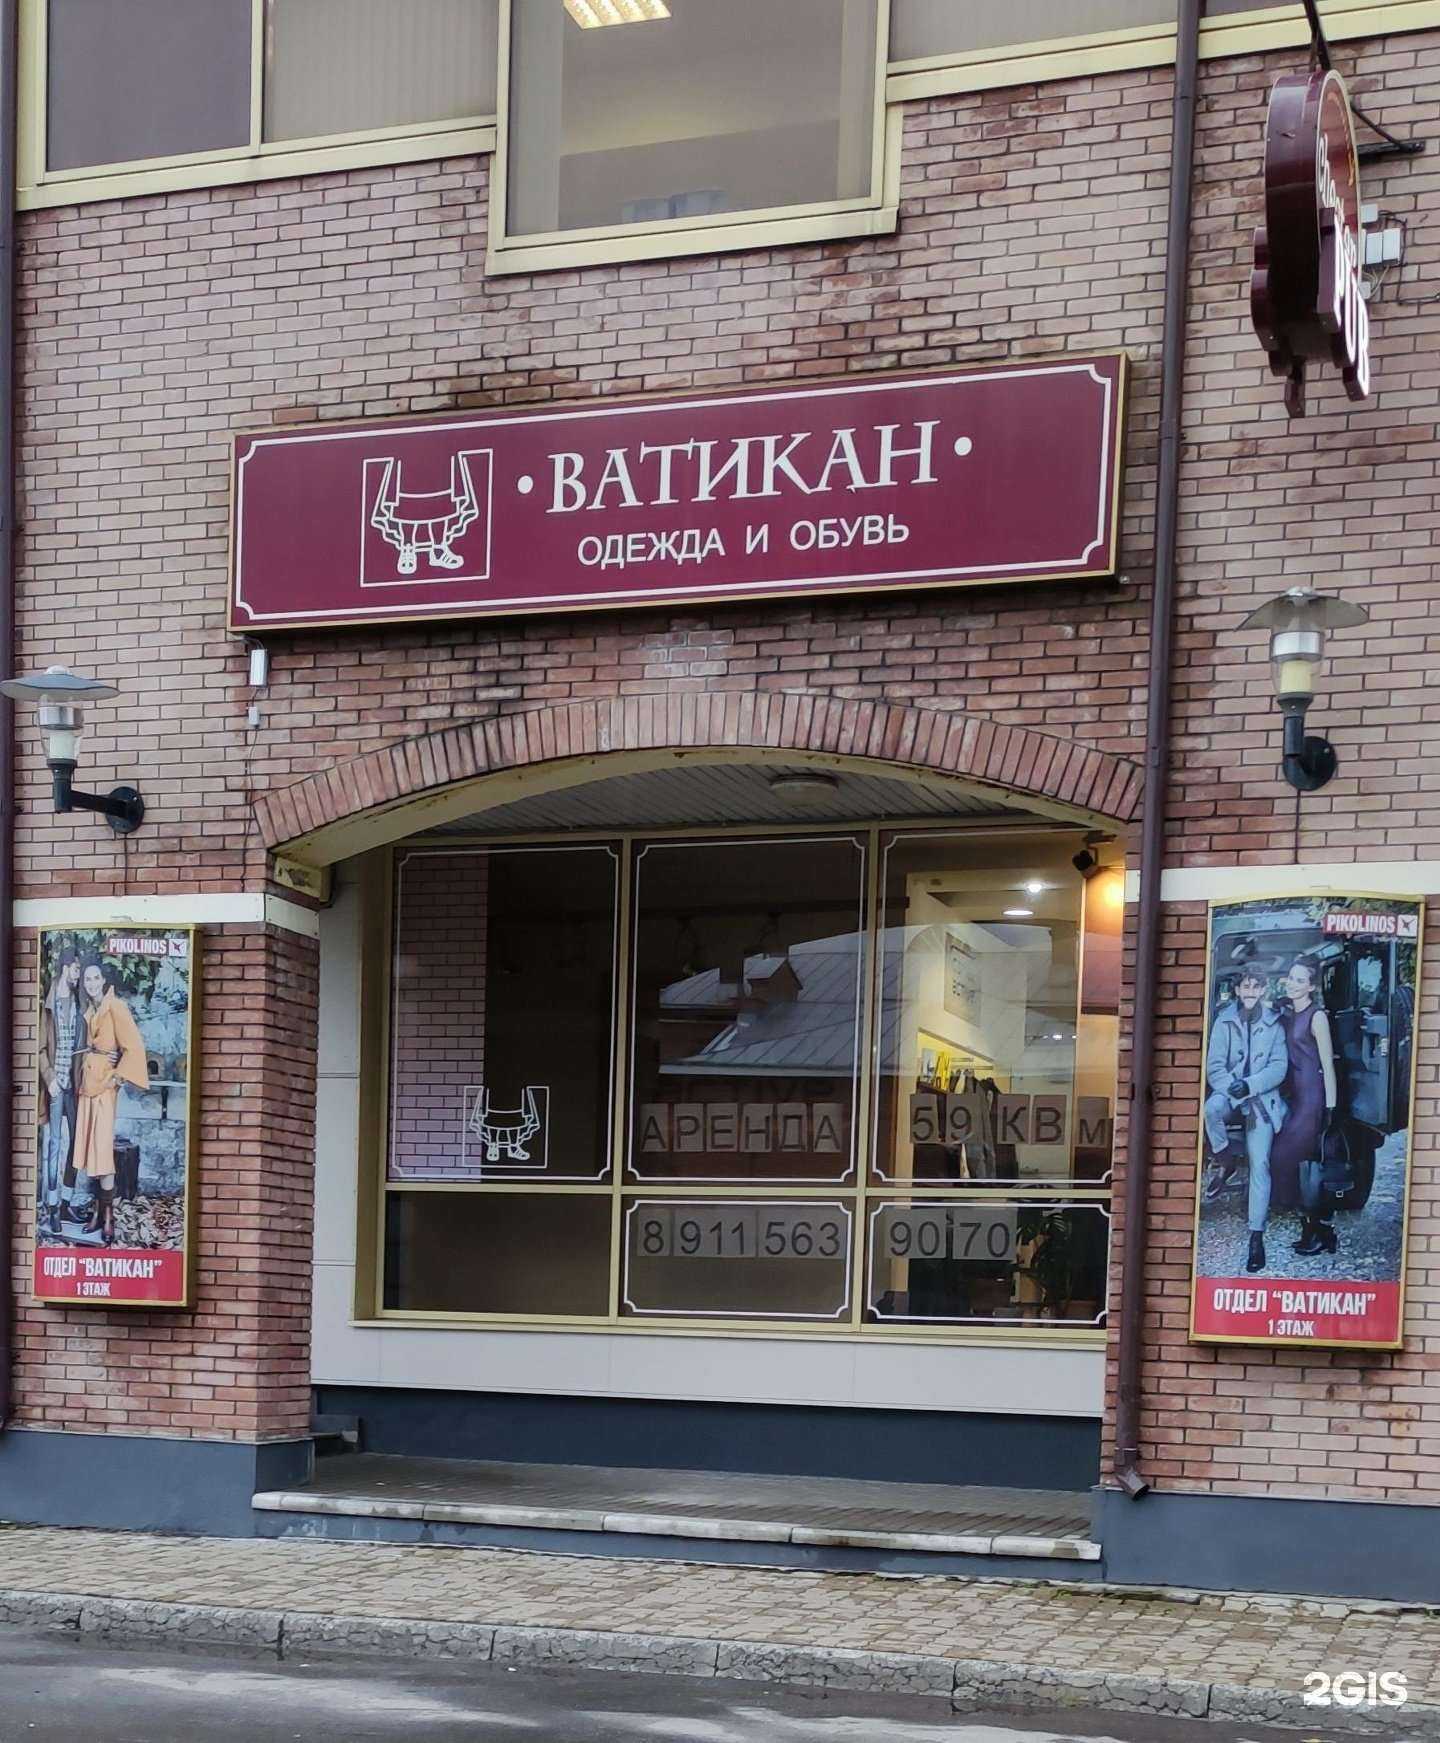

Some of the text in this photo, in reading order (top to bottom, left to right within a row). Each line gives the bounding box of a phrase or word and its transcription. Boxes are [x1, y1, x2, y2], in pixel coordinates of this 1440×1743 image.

[1333, 213, 1370, 396] PUB
[545, 420, 941, 514] ВАТИКАН
[577, 514, 910, 569] ОДЕЖДА И ОБУВЬ
[1327, 914, 1397, 934] PIKOLINOS
[109, 938, 167, 955] PIKOLINOS
[640, 1115, 841, 1151] АРЕНДА
[912, 1106, 973, 1142] 59
[1002, 1107, 1063, 1142] КВ
[959, 1222, 1010, 1258] 70
[43, 1256, 76, 1278] ОТДЕЛ
[76, 1282, 111, 1297] 1 ЭТАЖ
[1213, 1288, 1267, 1313] ОТДЕЛ
[1268, 1319, 1315, 1337] 1 ЭТАЖ
